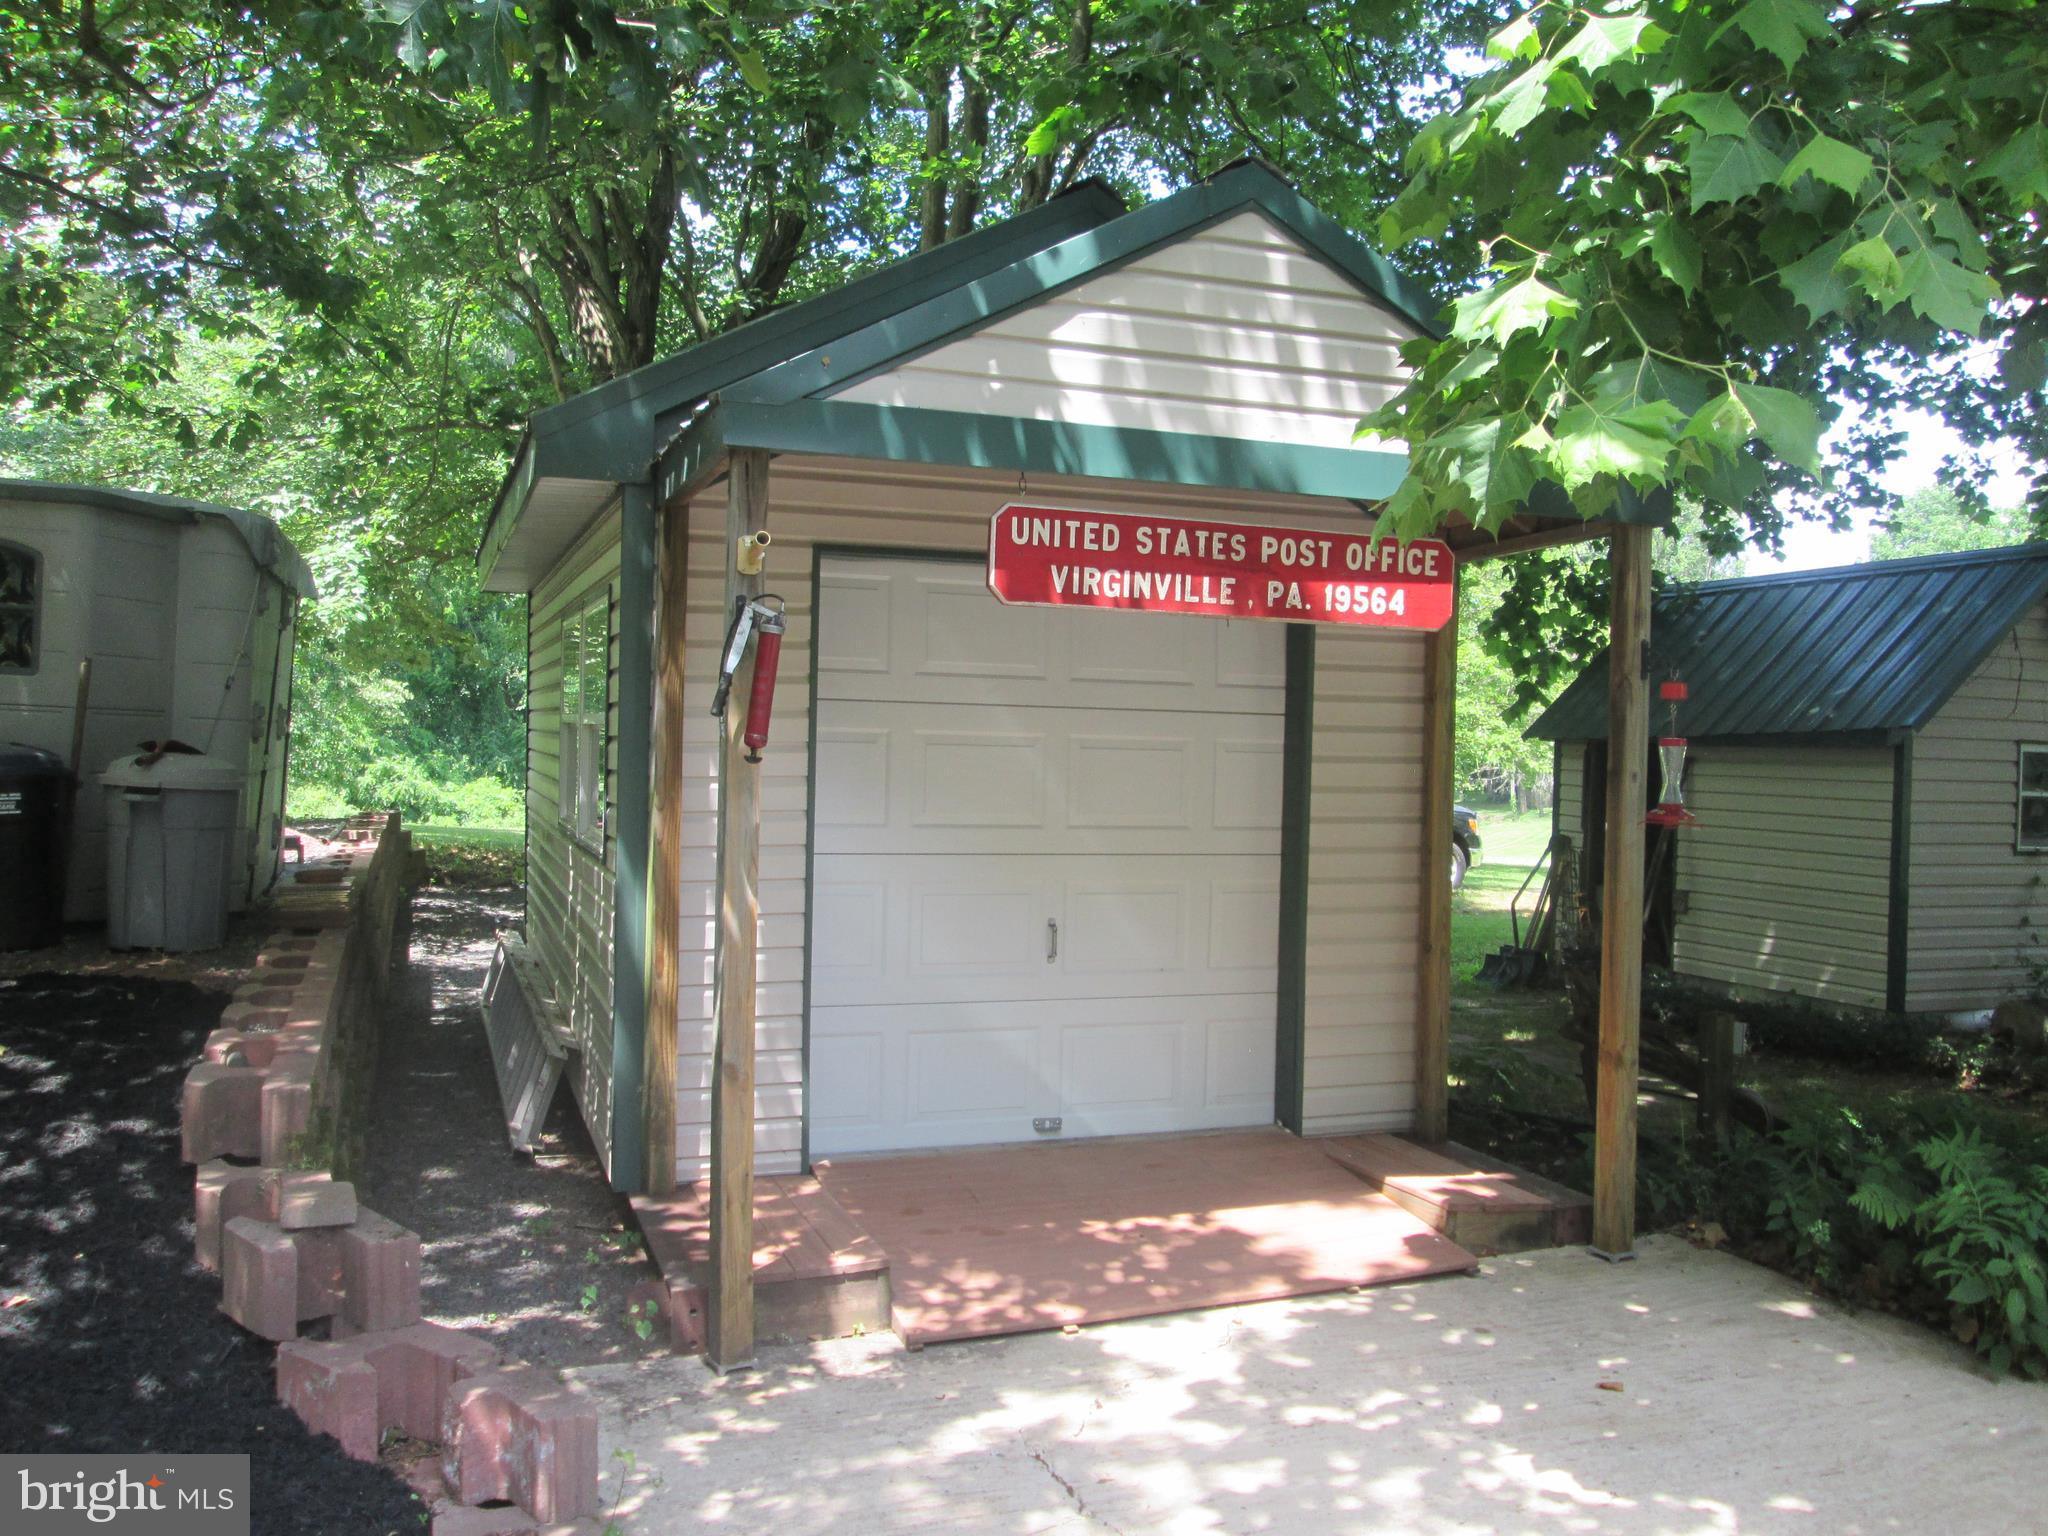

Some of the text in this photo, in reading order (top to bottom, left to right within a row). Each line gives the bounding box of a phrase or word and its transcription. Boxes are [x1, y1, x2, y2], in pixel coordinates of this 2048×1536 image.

[1011, 516, 1439, 577] UNITED STATES POST OFFICE
[1267, 580, 1312, 610] PA.
[1325, 583, 1405, 616] 19564
